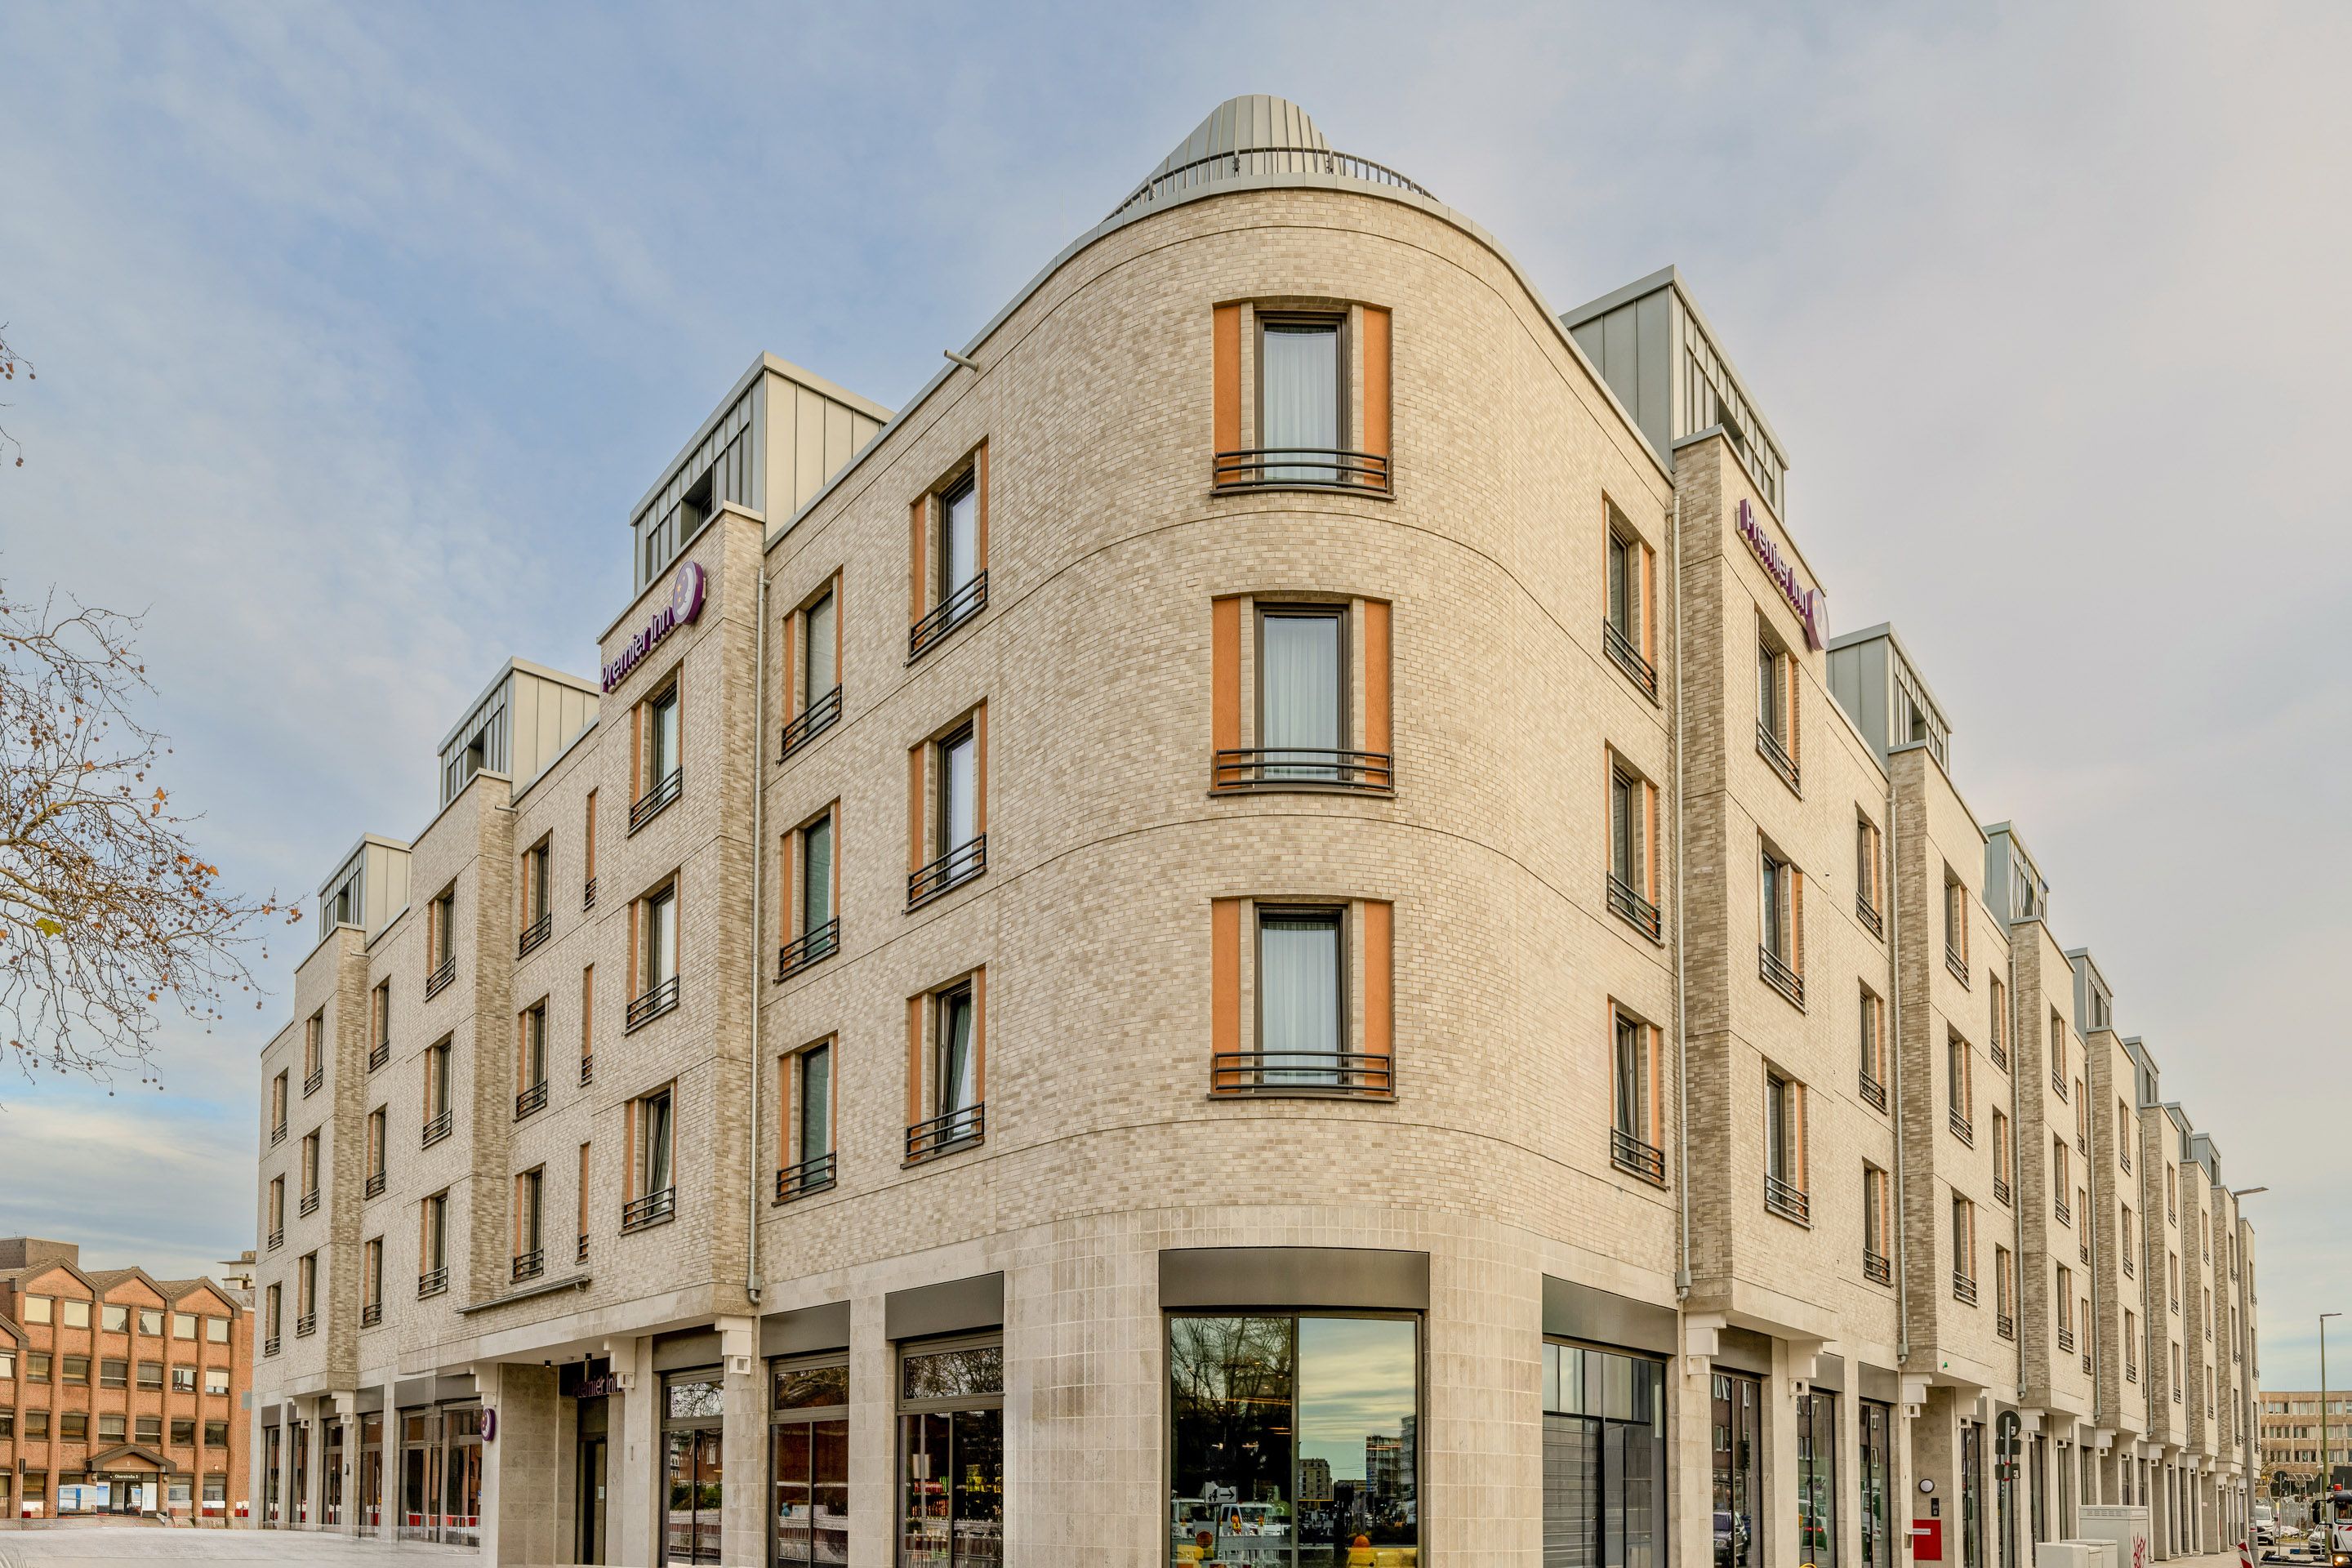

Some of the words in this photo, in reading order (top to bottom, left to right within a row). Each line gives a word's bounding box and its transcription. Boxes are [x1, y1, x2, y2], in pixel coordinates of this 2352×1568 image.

[1740, 498, 1793, 587] Premier
[1789, 571, 1808, 616] Inn
[603, 626, 651, 691] Premier
[651, 606, 675, 643] Inn
